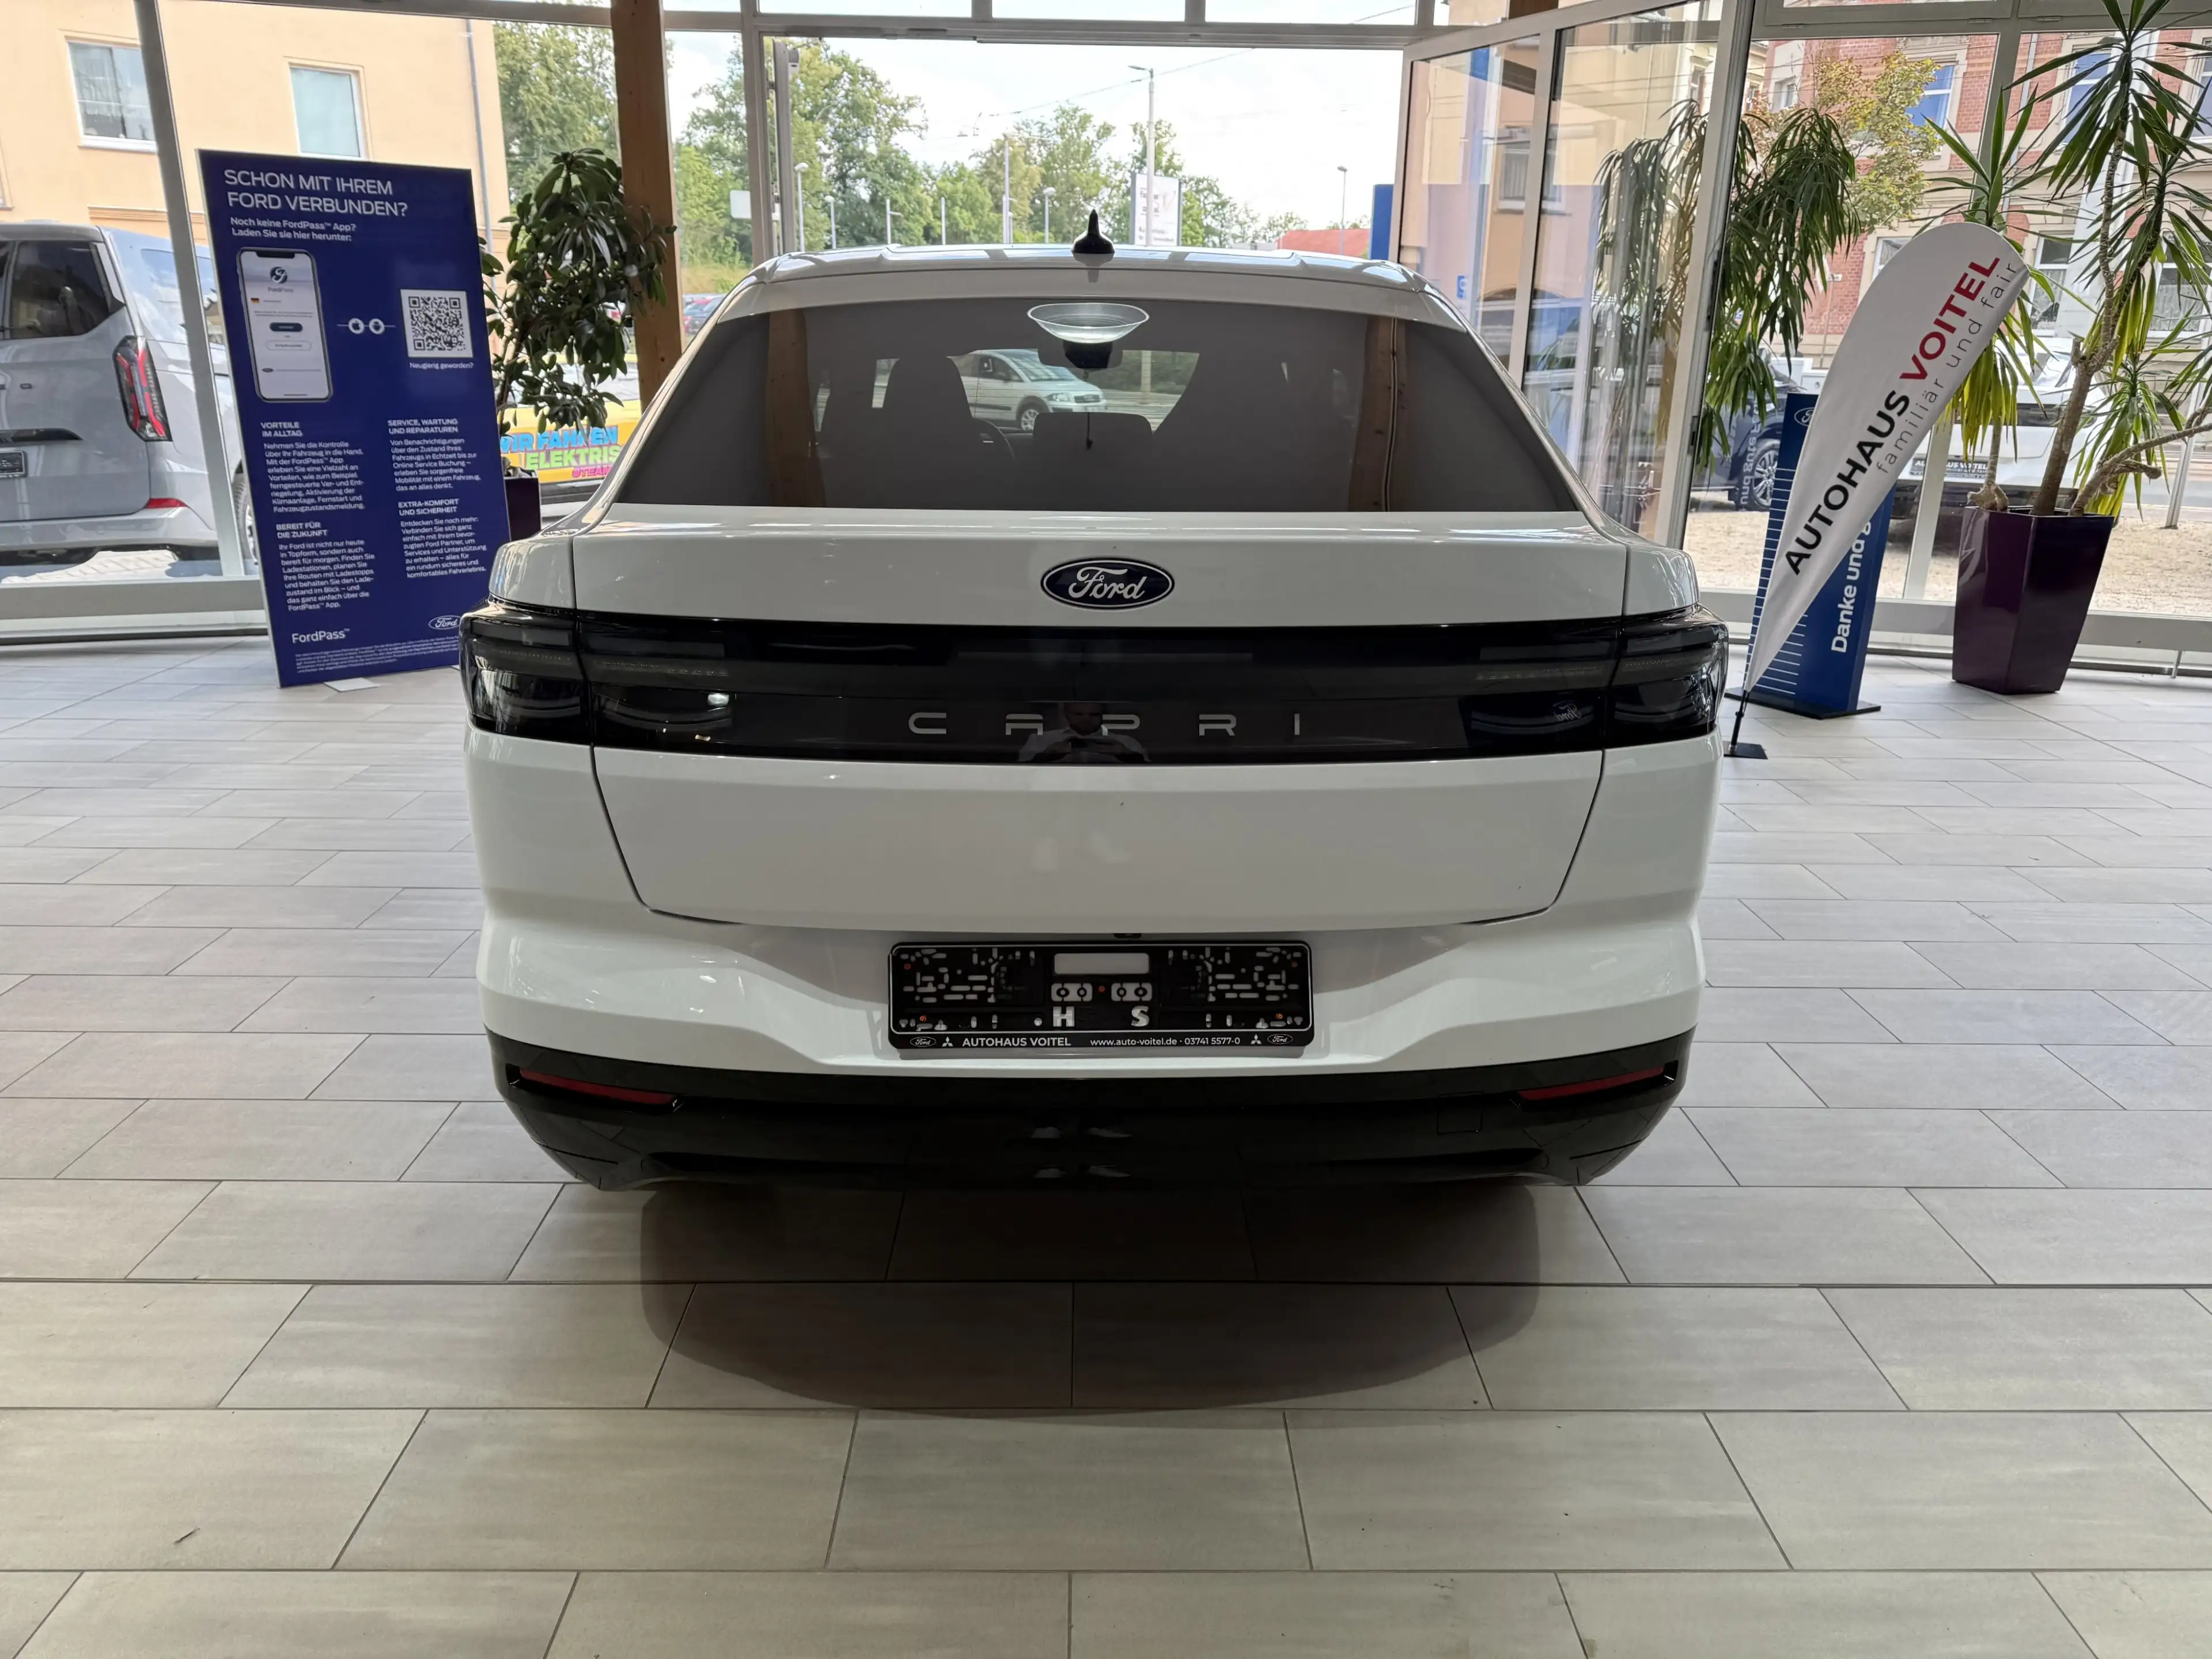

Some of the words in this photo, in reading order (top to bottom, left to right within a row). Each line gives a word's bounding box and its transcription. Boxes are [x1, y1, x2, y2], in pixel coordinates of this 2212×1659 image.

[224, 169, 294, 188] SCHON
[299, 174, 331, 191] MIT
[336, 177, 393, 195] IHREM
[228, 191, 282, 209] FORD
[285, 195, 408, 216] VERBUNDEN?
[230, 218, 255, 226] Noch
[257, 219, 281, 228] keine
[333, 223, 356, 232] App?
[232, 228, 261, 237] Laden
[263, 229, 277, 238] Sie
[312, 233, 352, 241] herunter:
[1876, 379, 1945, 473] familiär
[1946, 319, 1982, 368] und
[1982, 260, 2018, 308] fair
[1785, 390, 1911, 576] AUTOHAUS
[1899, 256, 2001, 380] VOITEL
[398, 498, 460, 508] EXTRA-KOMFORT
[416, 506, 457, 514] SICHERHEIT
[276, 522, 304, 531] BEREIT
[305, 521, 321, 529] FÜR
[292, 529, 328, 538] ZUKUNFT
[1068, 567, 1147, 601] Ford
[435, 617, 458, 628] Ford
[1831, 585, 1857, 653] Danke
[908, 711, 1301, 737] CAPRI
[1052, 1006, 1075, 1027] H
[1131, 1006, 1150, 1027] S
[962, 1037, 1027, 1047] AUTOHAUS
[1030, 1037, 1071, 1046] VOITEL
[1090, 1038, 1177, 1046] www.auto-voitel.de
[1211, 1037, 1240, 1045] 5577-0
